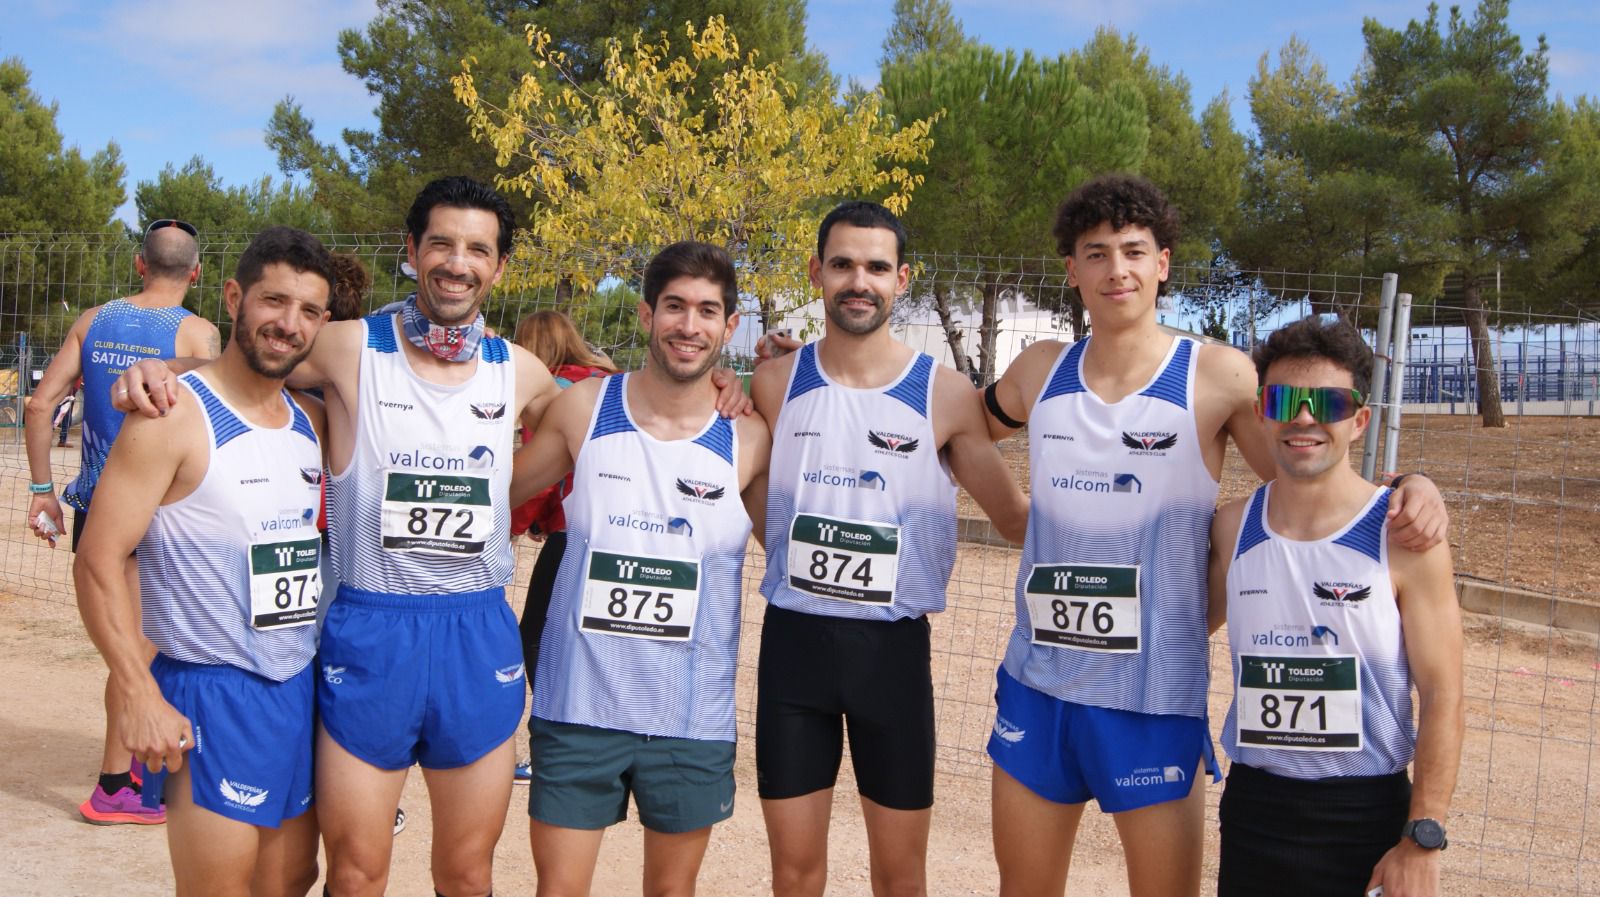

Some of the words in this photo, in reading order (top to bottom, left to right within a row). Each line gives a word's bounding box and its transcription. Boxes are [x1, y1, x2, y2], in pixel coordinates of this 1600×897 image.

[94, 340, 113, 349] CLUB
[114, 343, 160, 355] ATLETISMO
[92, 351, 142, 367] SATUR
[389, 449, 465, 471] valcom
[803, 470, 856, 488] valcom
[1075, 469, 1107, 477] sistemas
[1051, 475, 1109, 492] valcom
[261, 515, 301, 531] valcom
[407, 507, 474, 539] 872
[608, 513, 665, 535] valcom
[840, 530, 871, 540] TOLEDO
[640, 566, 672, 575] TOLEDO
[809, 550, 874, 588] 874
[1074, 575, 1107, 583] TOLEDO
[812, 584, 864, 597] www.diputoledo.es
[607, 587, 675, 623] 875
[1051, 599, 1115, 634] 876
[610, 622, 664, 633] www.diputoledo.es
[1252, 630, 1308, 647] valcom
[1288, 667, 1324, 676] TOLEDO
[1260, 694, 1328, 731] 871
[1266, 734, 1325, 743] www.diputoledo.es
[1115, 774, 1162, 786] valcom
